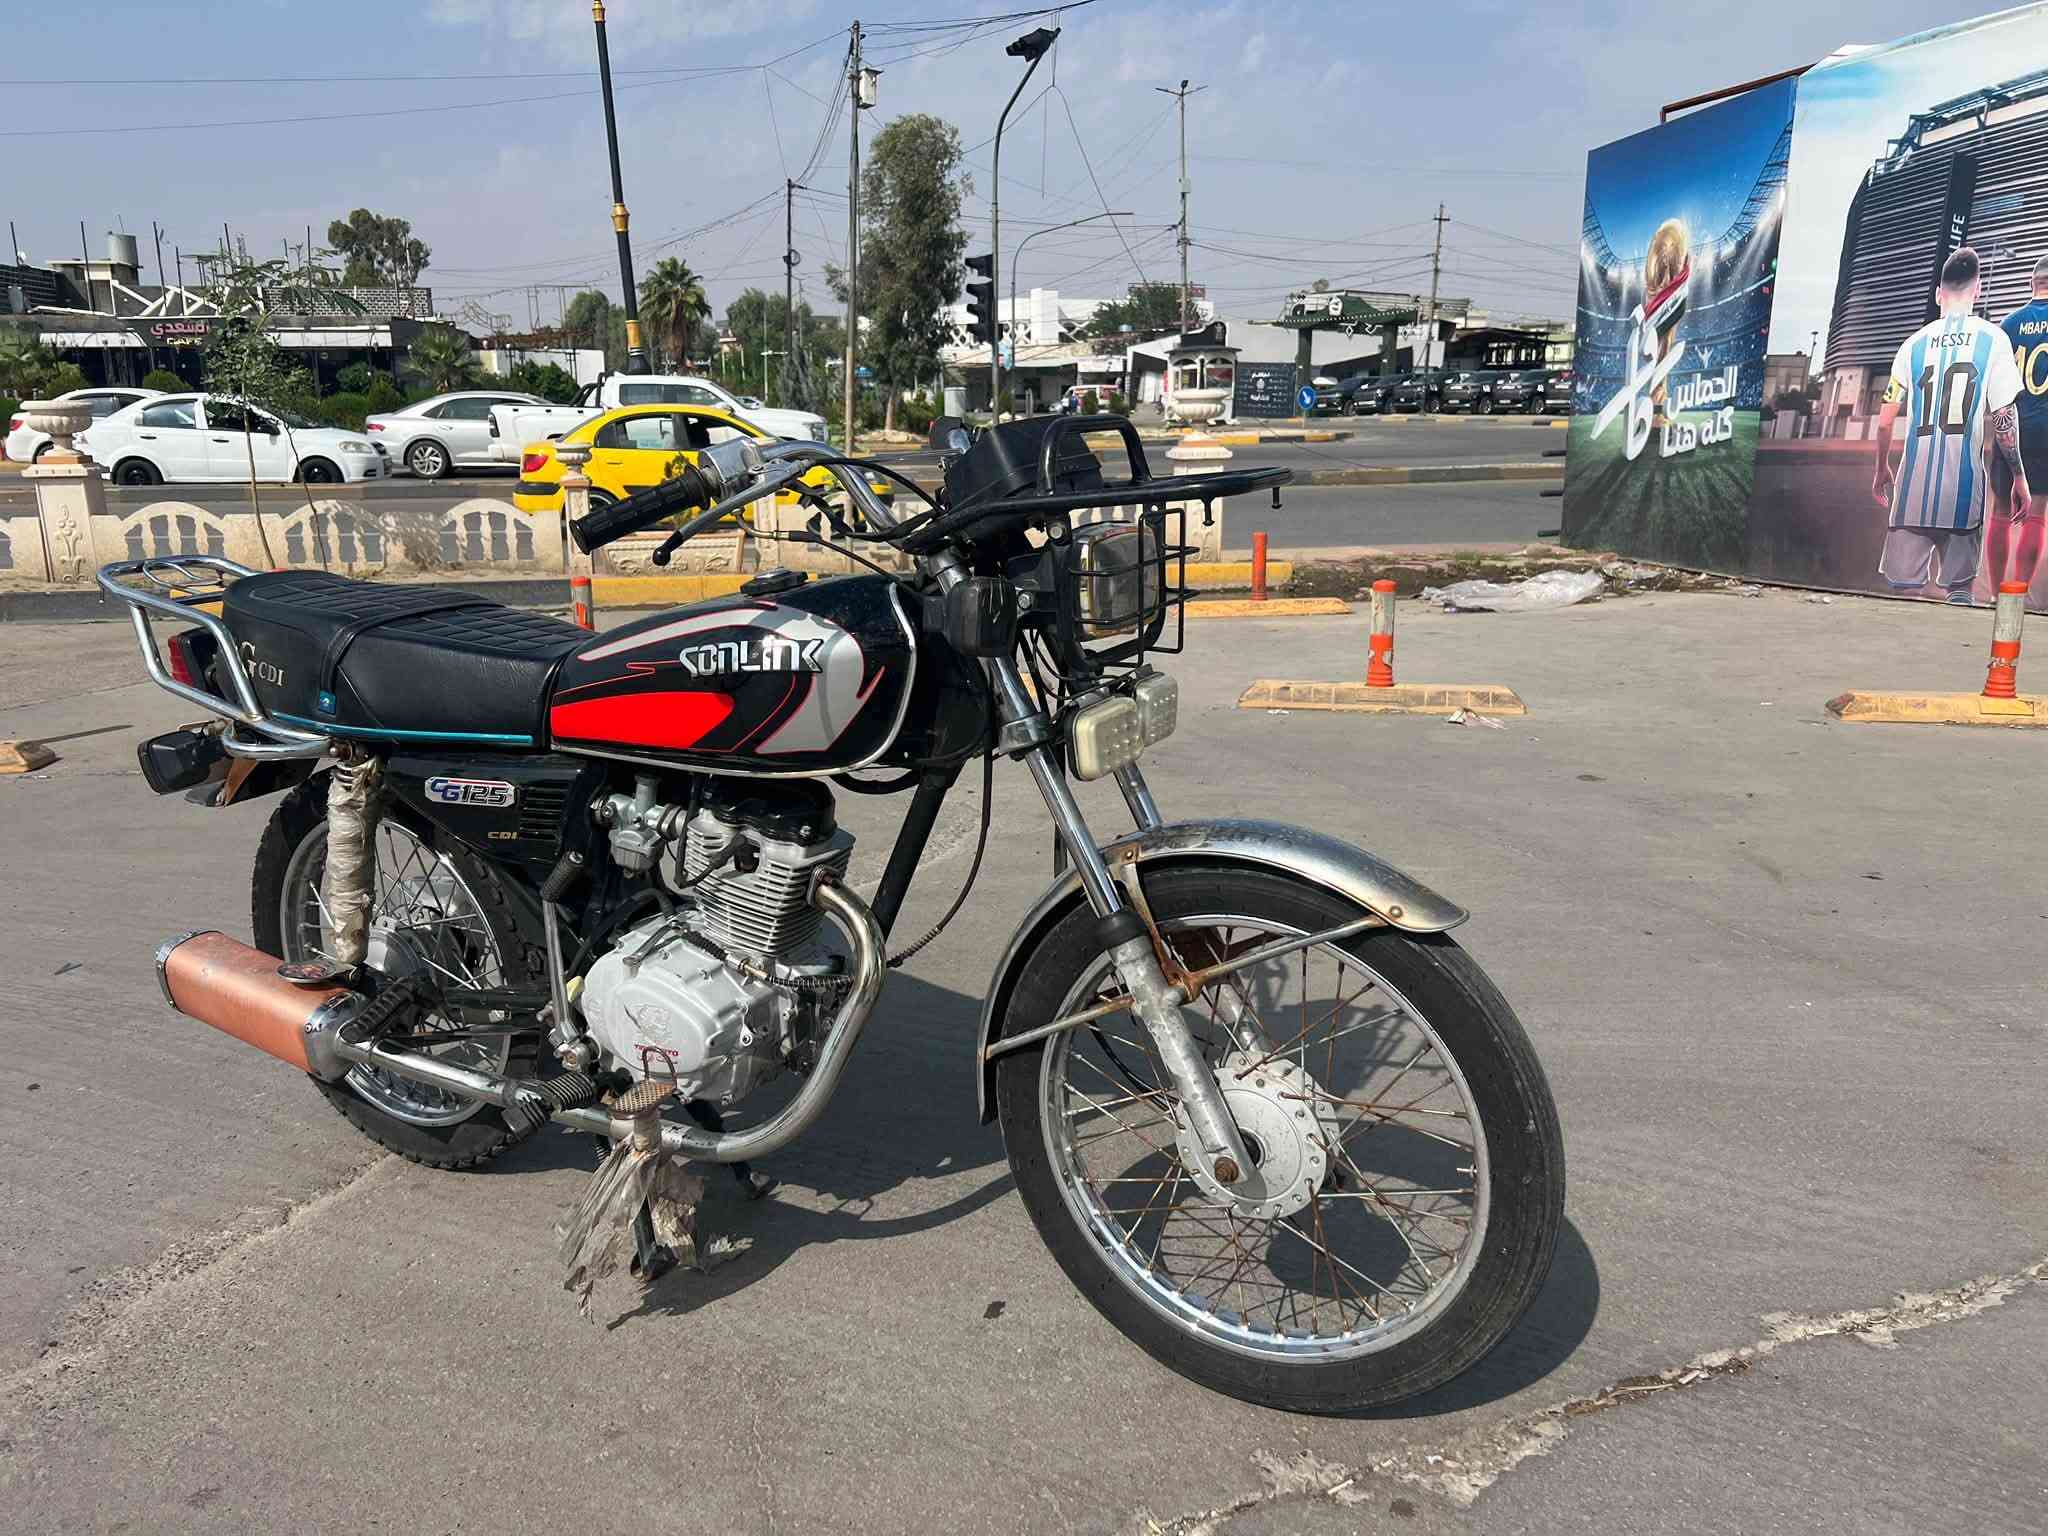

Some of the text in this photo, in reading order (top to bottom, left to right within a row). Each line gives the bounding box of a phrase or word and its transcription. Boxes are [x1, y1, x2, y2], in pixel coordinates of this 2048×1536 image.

[1948, 213, 1966, 257] LIFE
[1930, 332, 1973, 348] MESSI
[2018, 320, 2048, 337] MBAP
[1665, 365, 1738, 420] الحماس
[1916, 361, 1980, 438] 10
[1658, 405, 1735, 458] كله هنا
[258, 661, 285, 687] CDI
[487, 831, 519, 840] CDI
